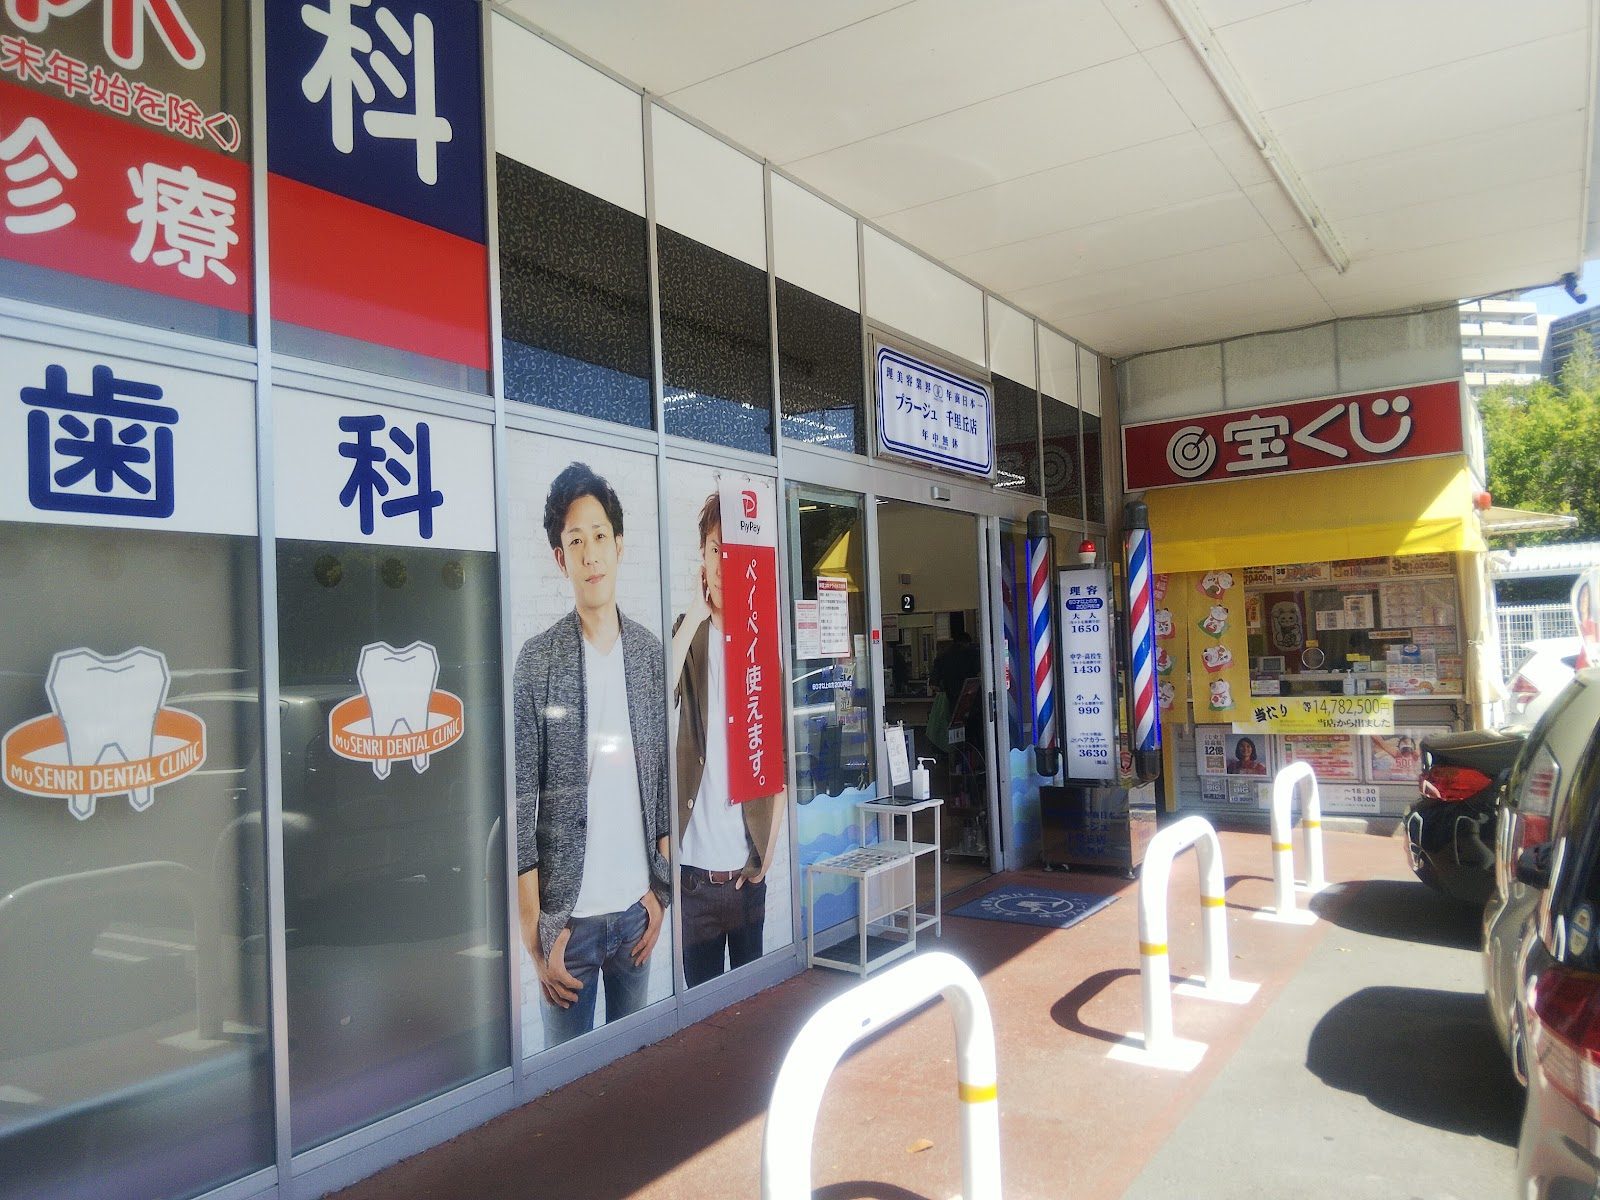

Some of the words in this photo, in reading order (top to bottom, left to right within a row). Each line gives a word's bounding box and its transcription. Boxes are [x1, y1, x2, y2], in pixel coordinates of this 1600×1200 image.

[301, 0, 453, 186] 科
[895, 393, 938, 421] プラージュ
[946, 410, 977, 436] 千里丘店
[922, 429, 959, 448] 年中無休
[1223, 395, 1412, 472] 宝くじ
[1070, 585, 1098, 596] 理容
[904, 596, 911, 610] 2
[1071, 624, 1100, 633] 1650
[745, 558, 766, 787] ペイペイ使えます。
[1073, 665, 1101, 674] 1430
[1078, 706, 1101, 715] 990
[1254, 703, 1288, 723] 当たり
[350, 735, 383, 756] SENRI
[386, 733, 430, 756] DENTAL
[432, 717, 460, 746] CLINIC
[1079, 749, 1108, 758] 3630
[34, 765, 84, 791] SENRI
[90, 762, 155, 791] DENTAL
[159, 740, 201, 778] CLINIC
